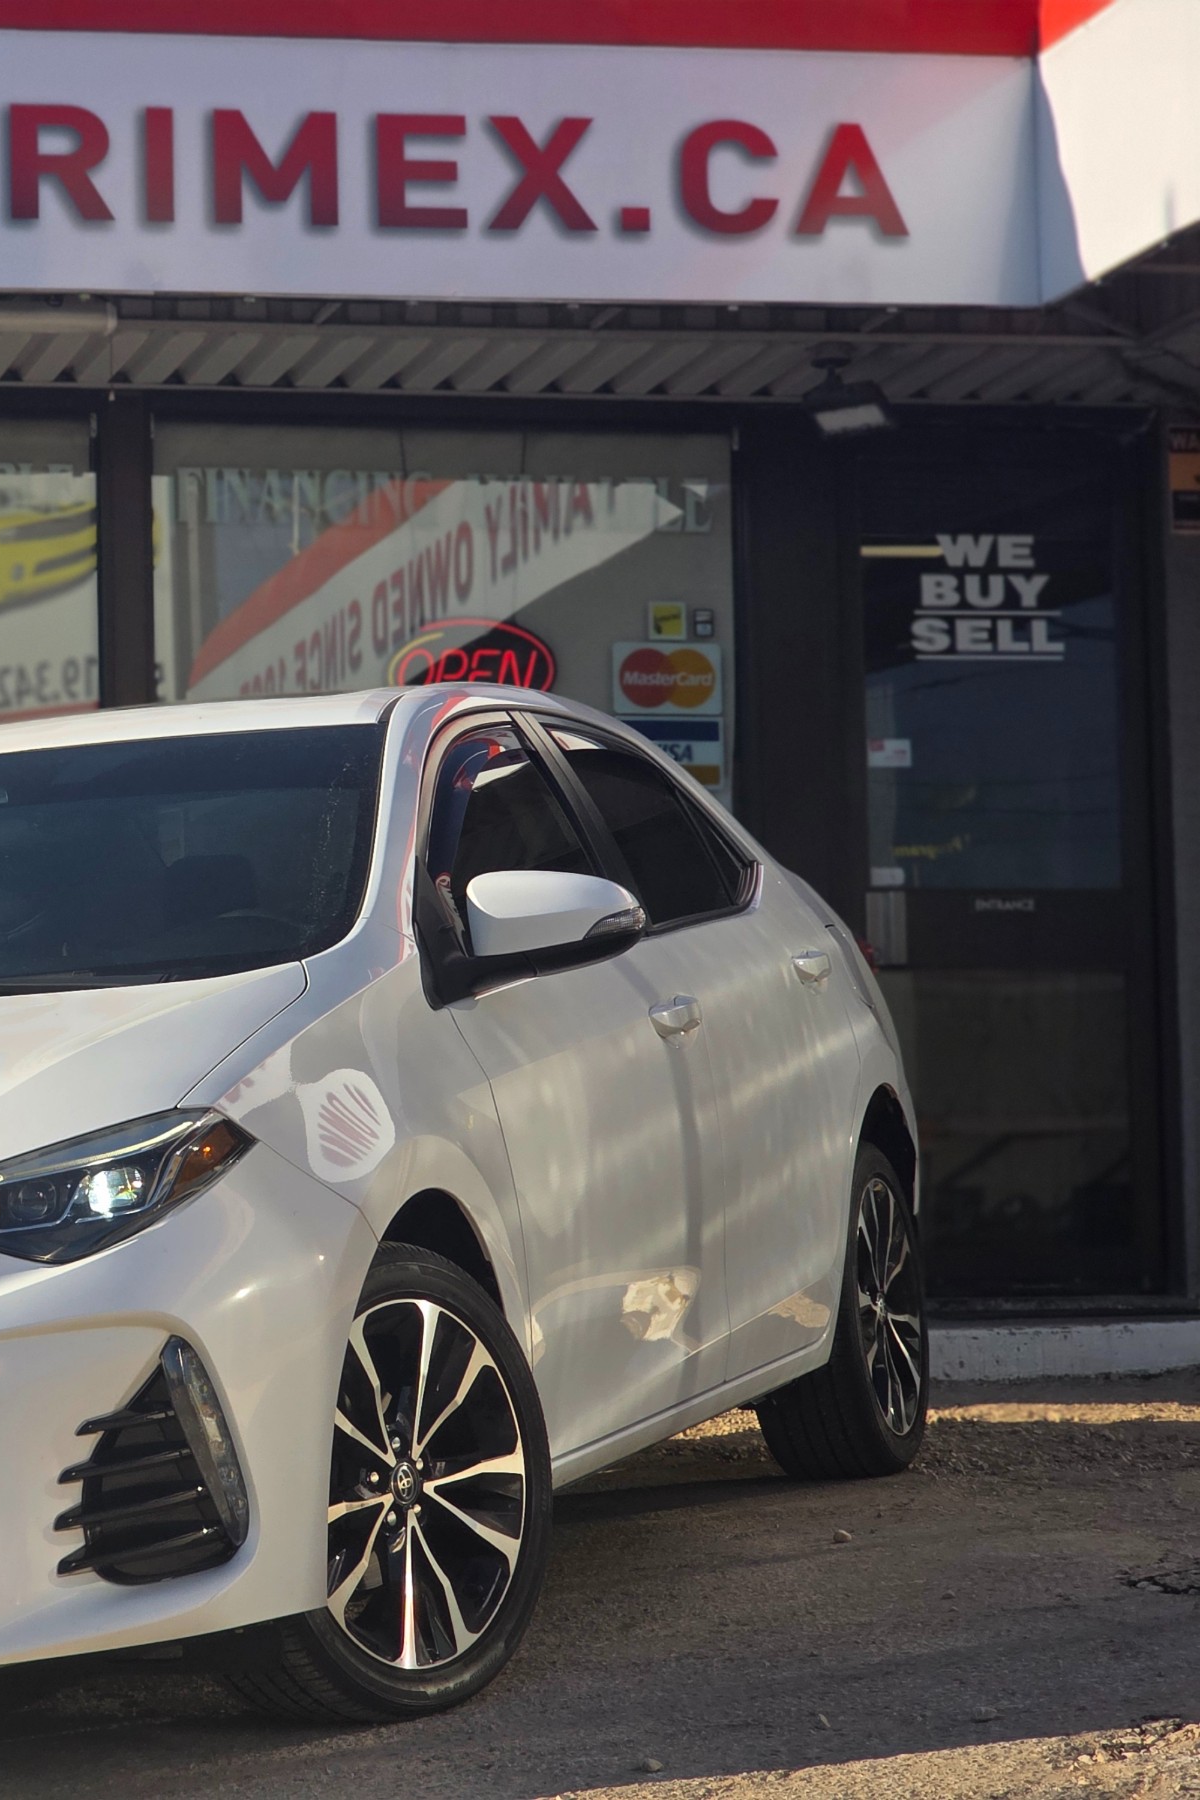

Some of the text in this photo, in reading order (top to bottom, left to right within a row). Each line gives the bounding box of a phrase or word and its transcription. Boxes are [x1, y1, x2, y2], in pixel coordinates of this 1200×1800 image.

[936, 534, 1036, 568] WE
[921, 574, 1050, 609] BUY
[910, 619, 1065, 652] SELL
[396, 648, 538, 689] OPEN
[623, 672, 712, 687] MasterCard
